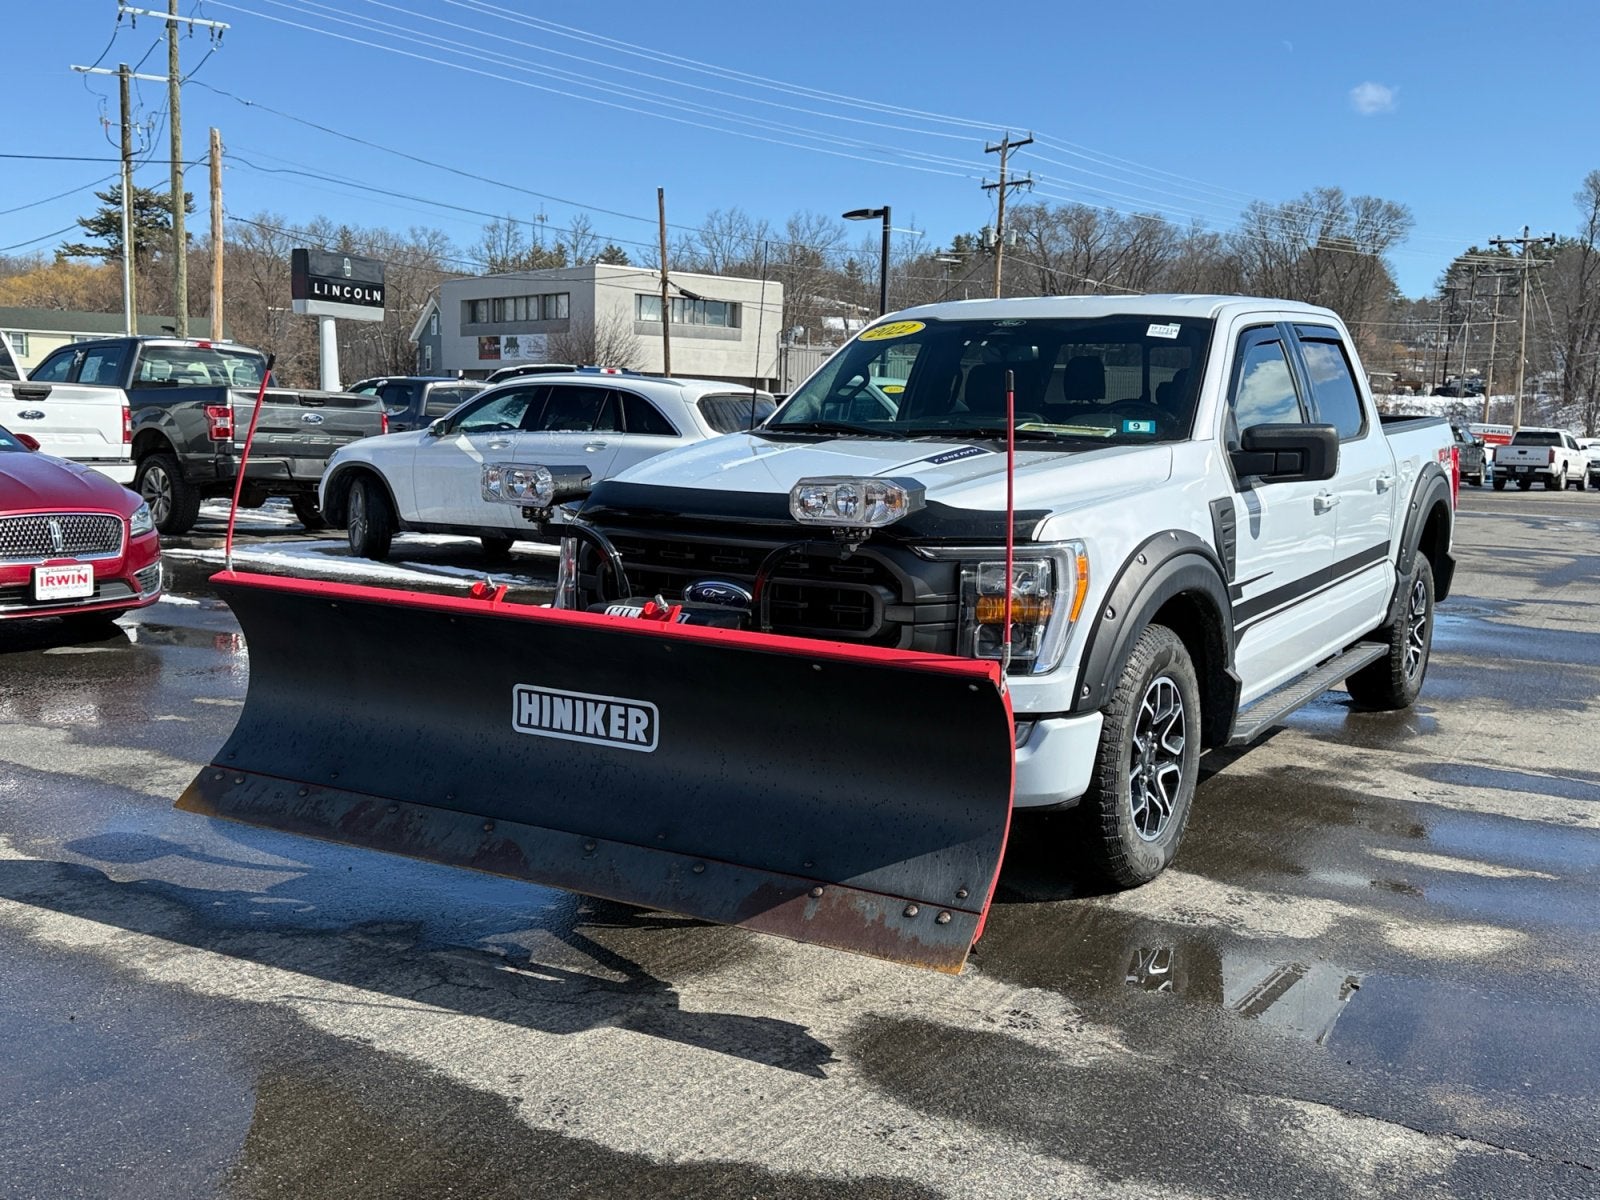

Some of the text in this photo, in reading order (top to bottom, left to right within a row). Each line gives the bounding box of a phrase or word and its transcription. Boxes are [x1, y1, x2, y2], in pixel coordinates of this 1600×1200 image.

[314, 282, 381, 301] LINCOLN
[1132, 422, 1141, 431] 9
[40, 573, 88, 587] IRWIN
[519, 691, 649, 743] HINIKER
